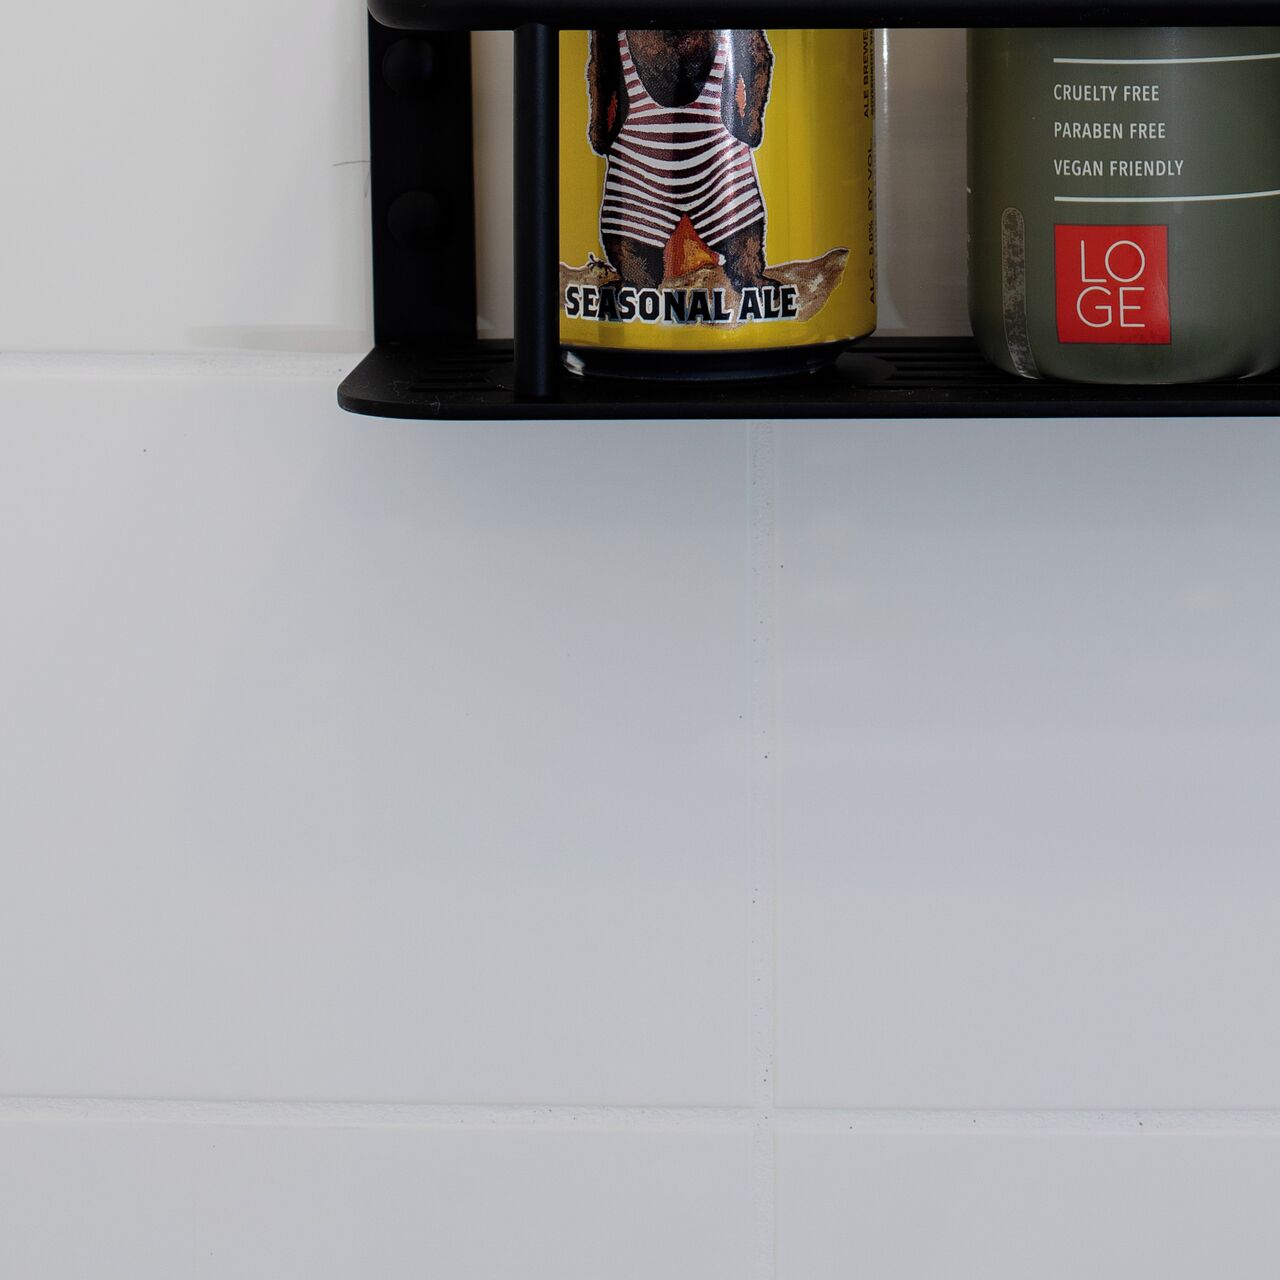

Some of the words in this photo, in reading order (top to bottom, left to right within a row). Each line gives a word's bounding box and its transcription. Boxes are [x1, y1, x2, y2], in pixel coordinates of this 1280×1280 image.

[1053, 84, 1118, 102] CRUELTY
[1123, 85, 1160, 102] FREE
[1054, 121, 1123, 139] PARABEN
[1130, 122, 1166, 139] FREE
[1053, 159, 1103, 177] VEGAN
[1110, 159, 1184, 177] FRIENDLY
[1080, 239, 1146, 283] LO
[565, 284, 733, 323] SEASONAL
[738, 284, 799, 321] ALE
[1076, 285, 1146, 328] GE
